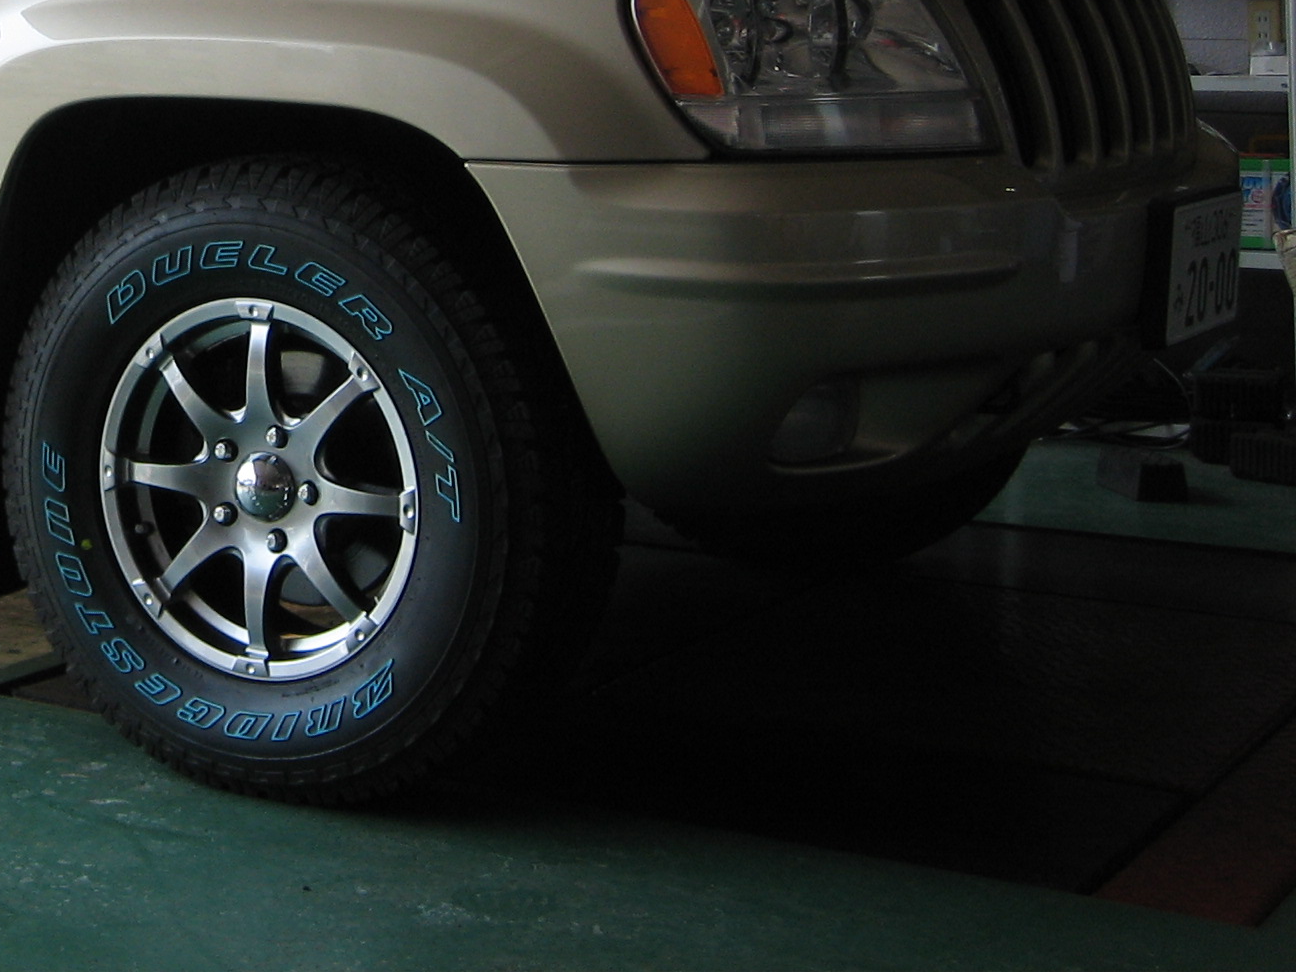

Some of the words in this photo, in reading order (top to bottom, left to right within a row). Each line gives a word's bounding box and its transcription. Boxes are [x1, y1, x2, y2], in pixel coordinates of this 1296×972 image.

[106, 240, 393, 341] DUELER
[397, 368, 461, 523] A/T
[41, 440, 395, 741] BRIDGESTONE
